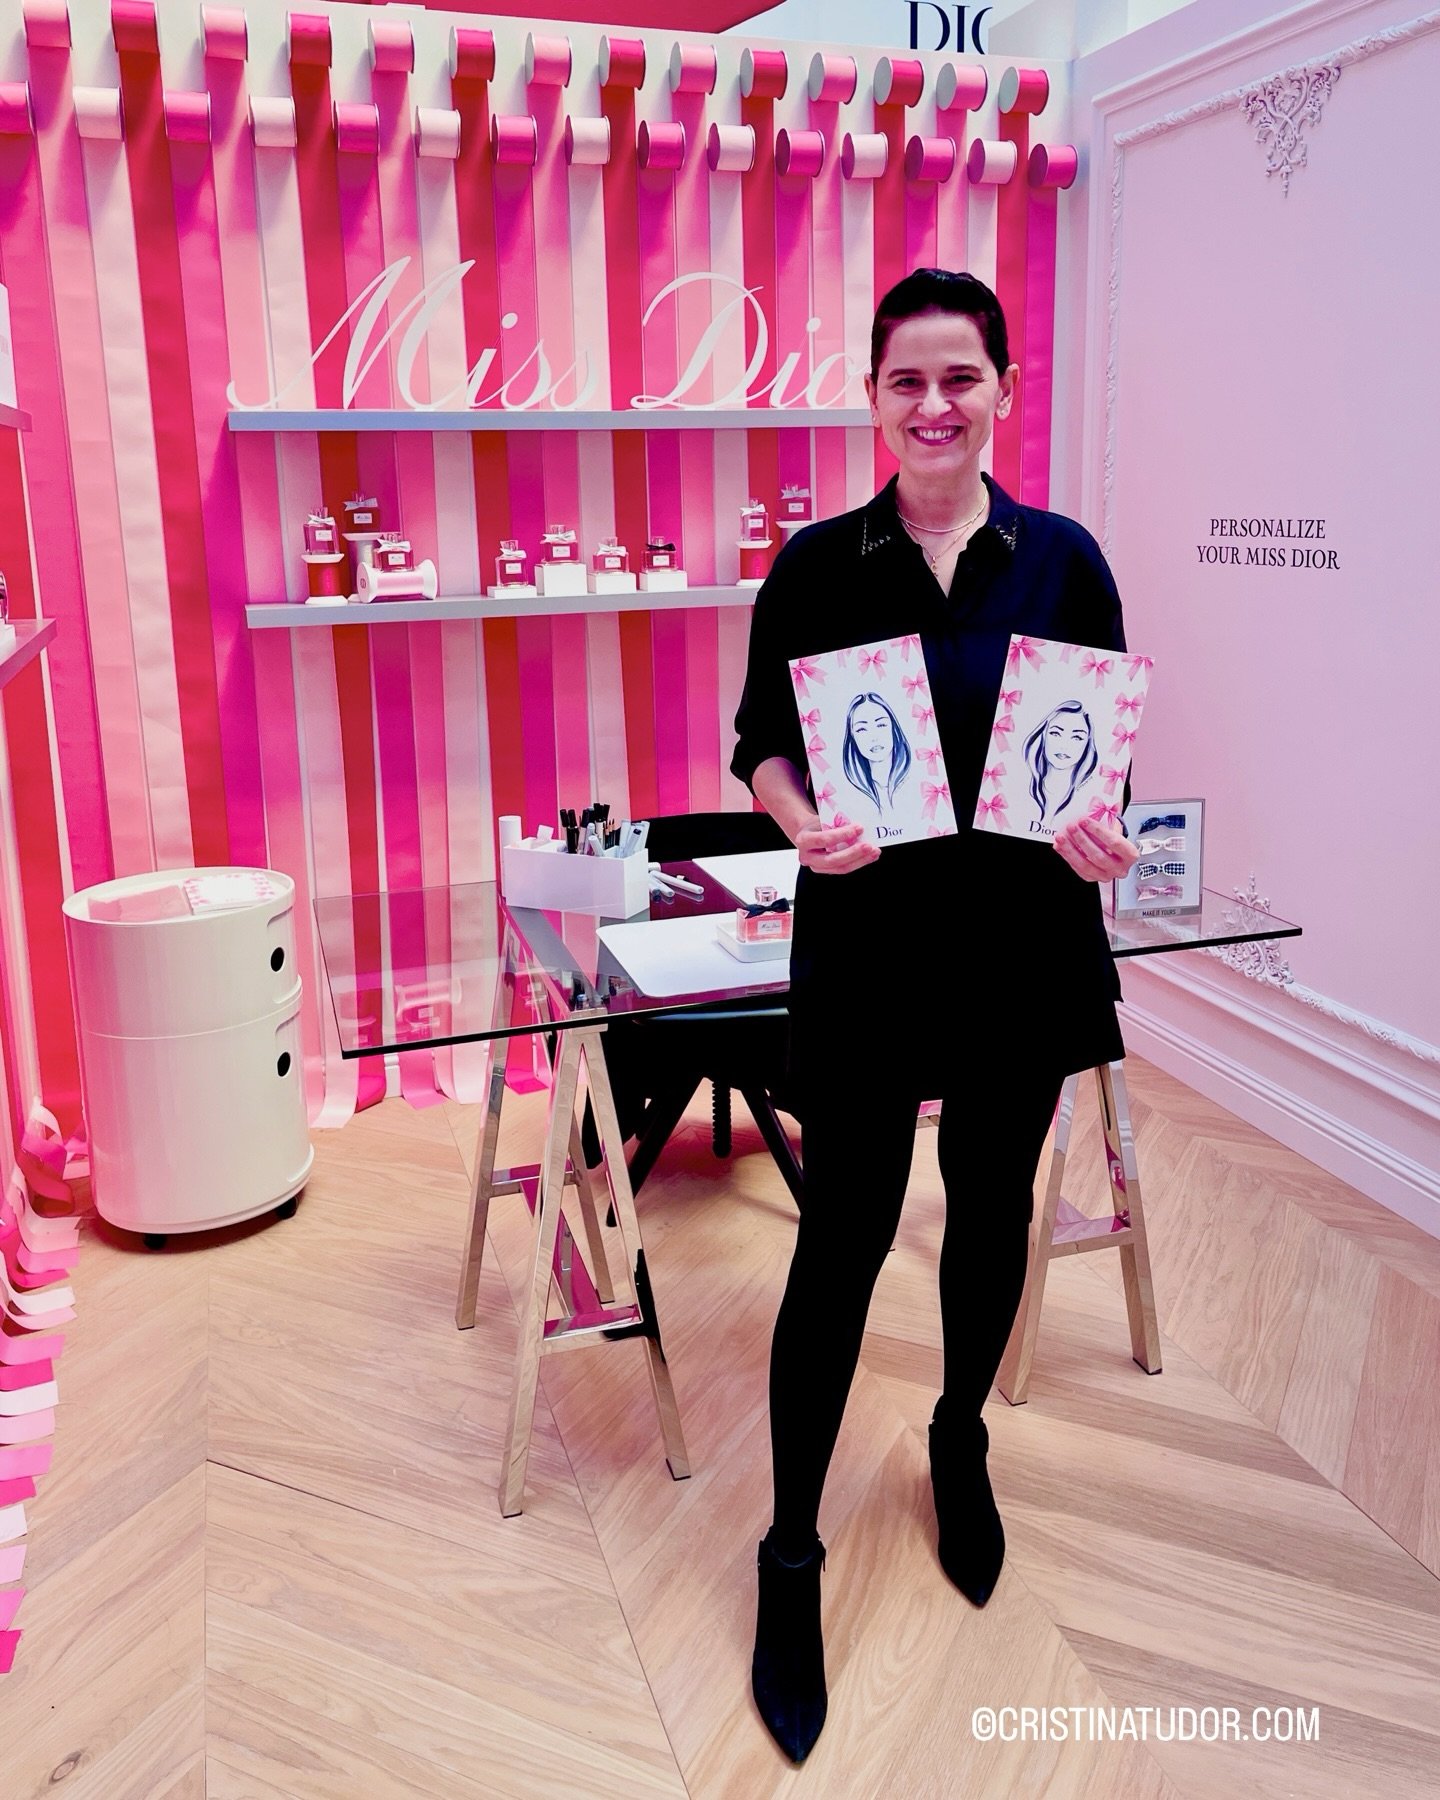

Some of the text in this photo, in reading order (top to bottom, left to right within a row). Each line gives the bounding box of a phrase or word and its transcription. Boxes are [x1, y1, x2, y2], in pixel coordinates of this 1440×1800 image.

[226, 255, 871, 411] Miss Dio
[1209, 518, 1326, 539] PERSONALIZE
[1196, 545, 1341, 570] YOUR MISS DIOR
[876, 826, 904, 839] Dior
[1029, 820, 1057, 837] Dior
